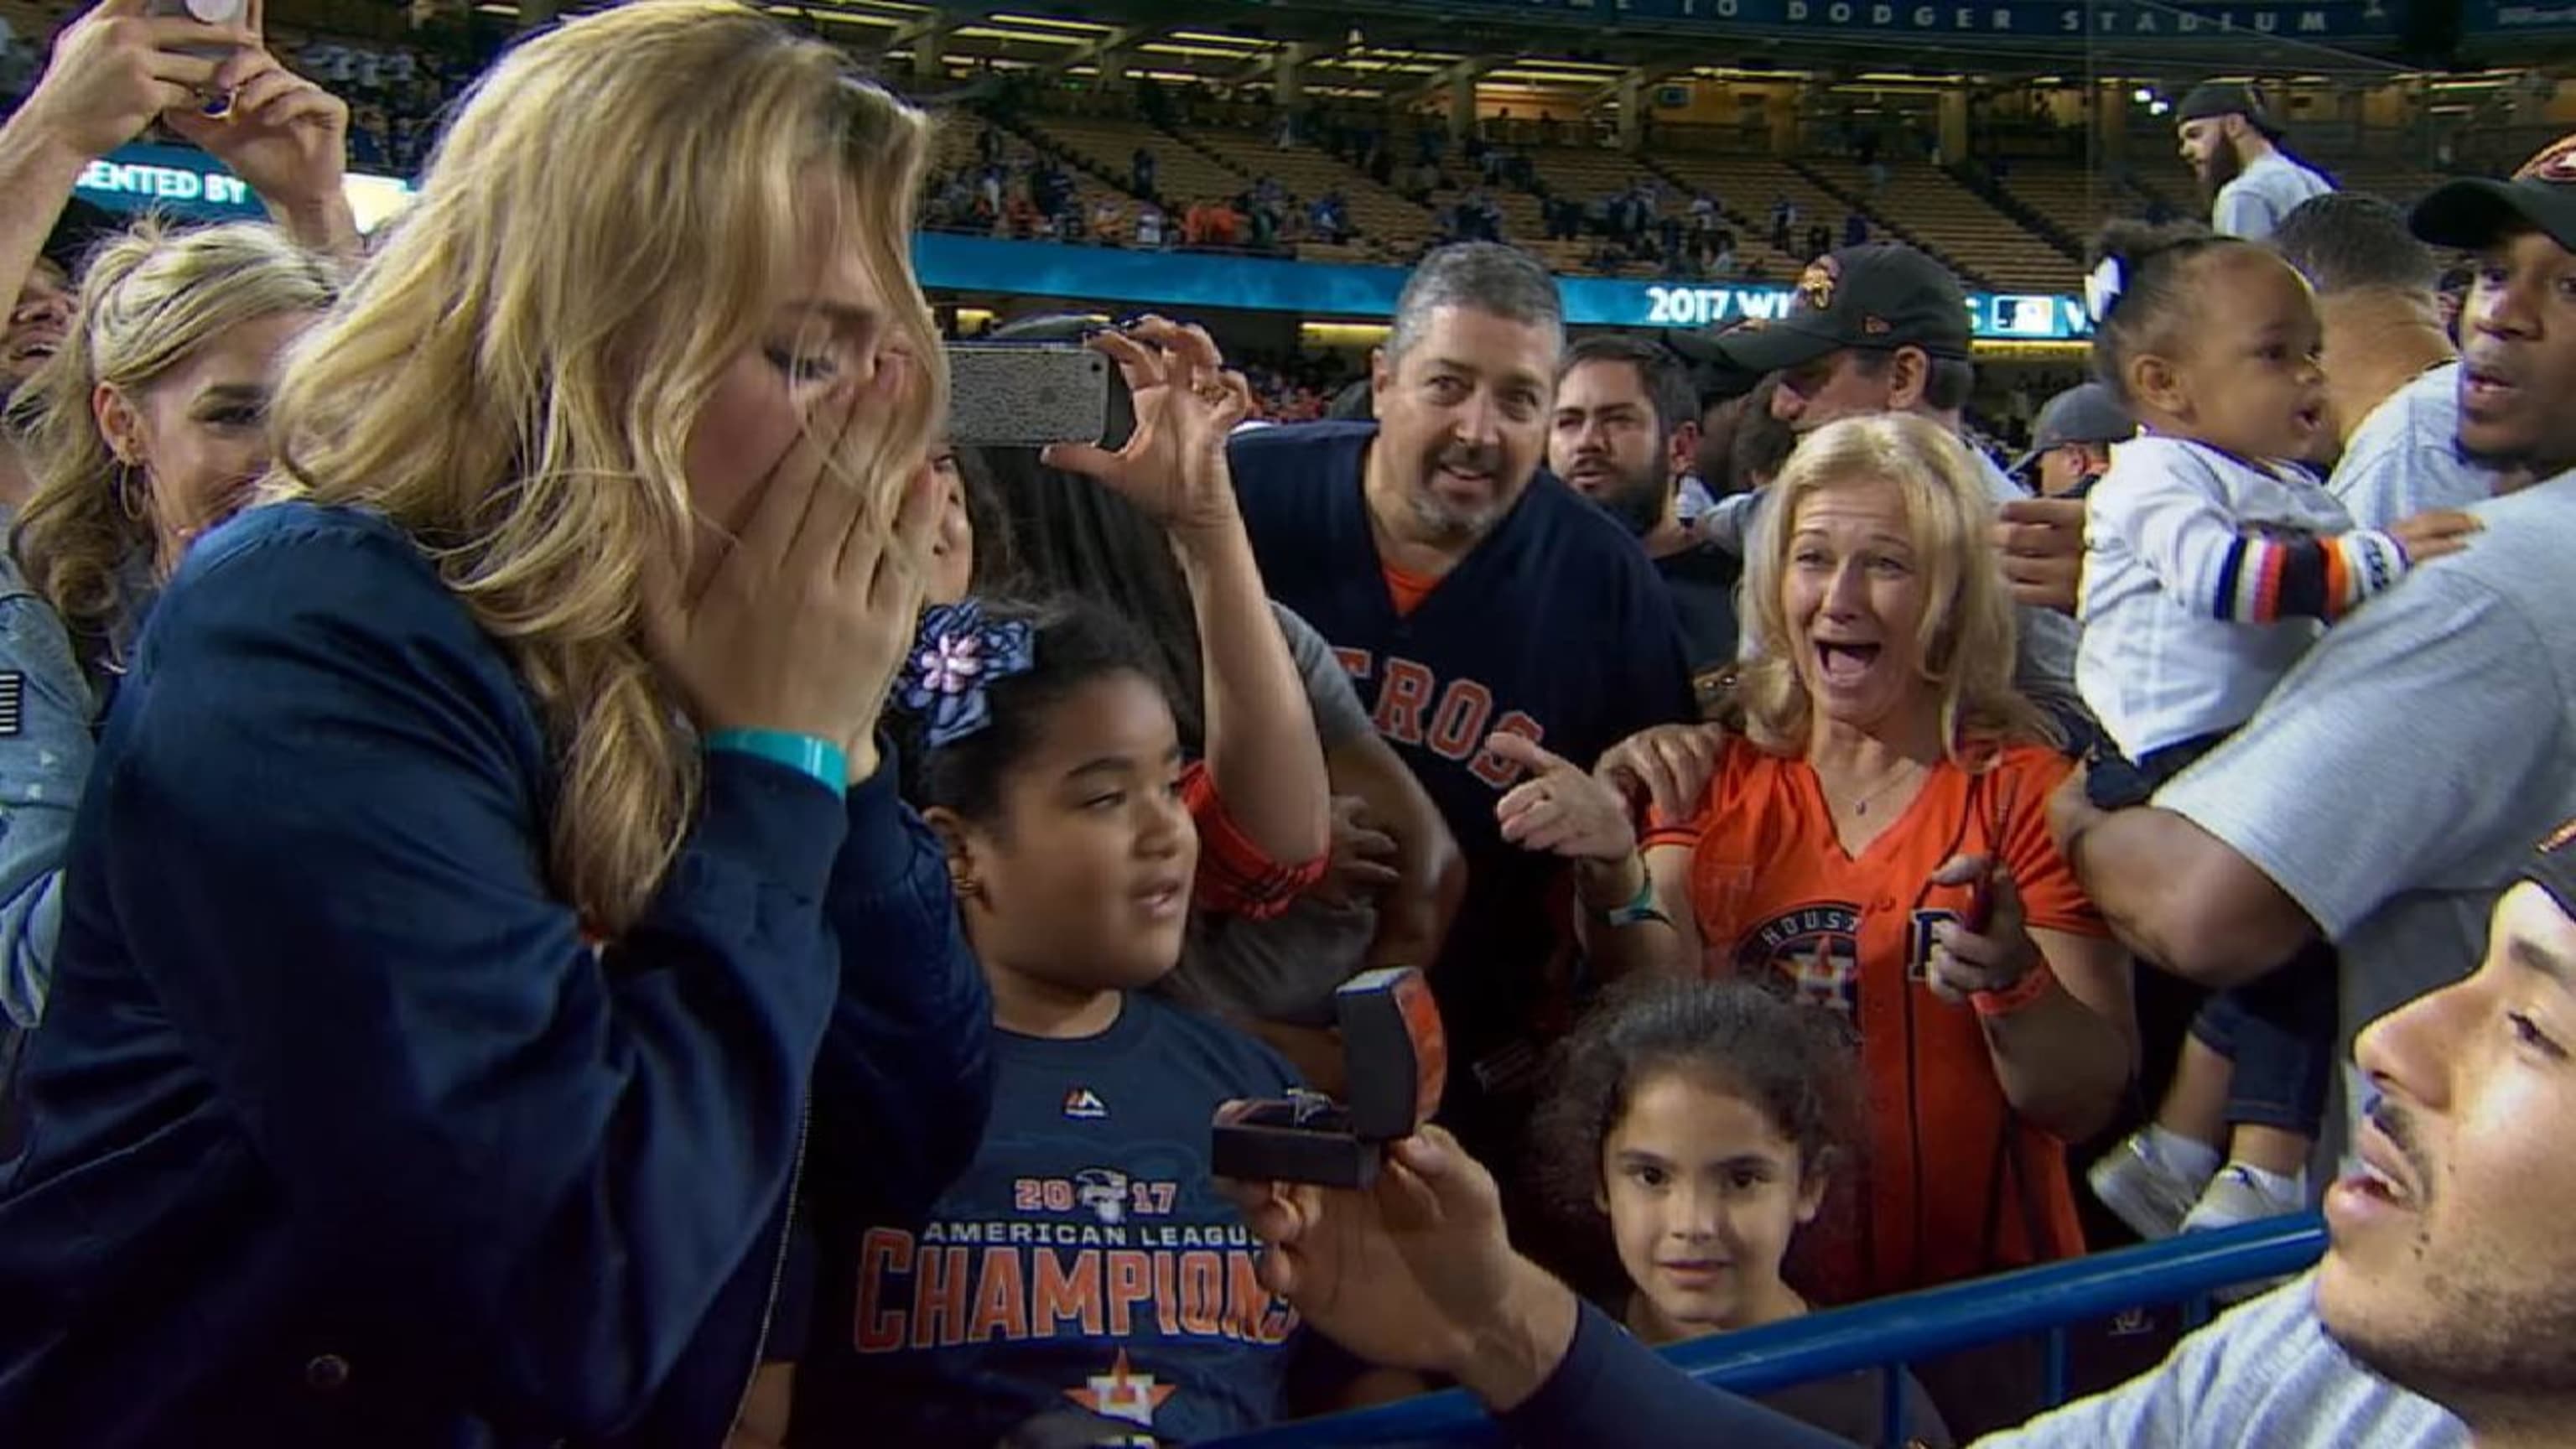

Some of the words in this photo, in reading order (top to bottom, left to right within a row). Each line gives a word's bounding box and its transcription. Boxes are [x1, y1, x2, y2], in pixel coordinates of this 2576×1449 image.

[1786, 3, 2012, 29] DODGER
[2059, 9, 2329, 33] STADIUM
[205, 173, 247, 204] BY
[1645, 286, 1730, 324] 2017
[1014, 1179, 1076, 1211] 20
[1132, 1181, 1177, 1213] 17
[922, 1222, 1127, 1247] AMERICAN
